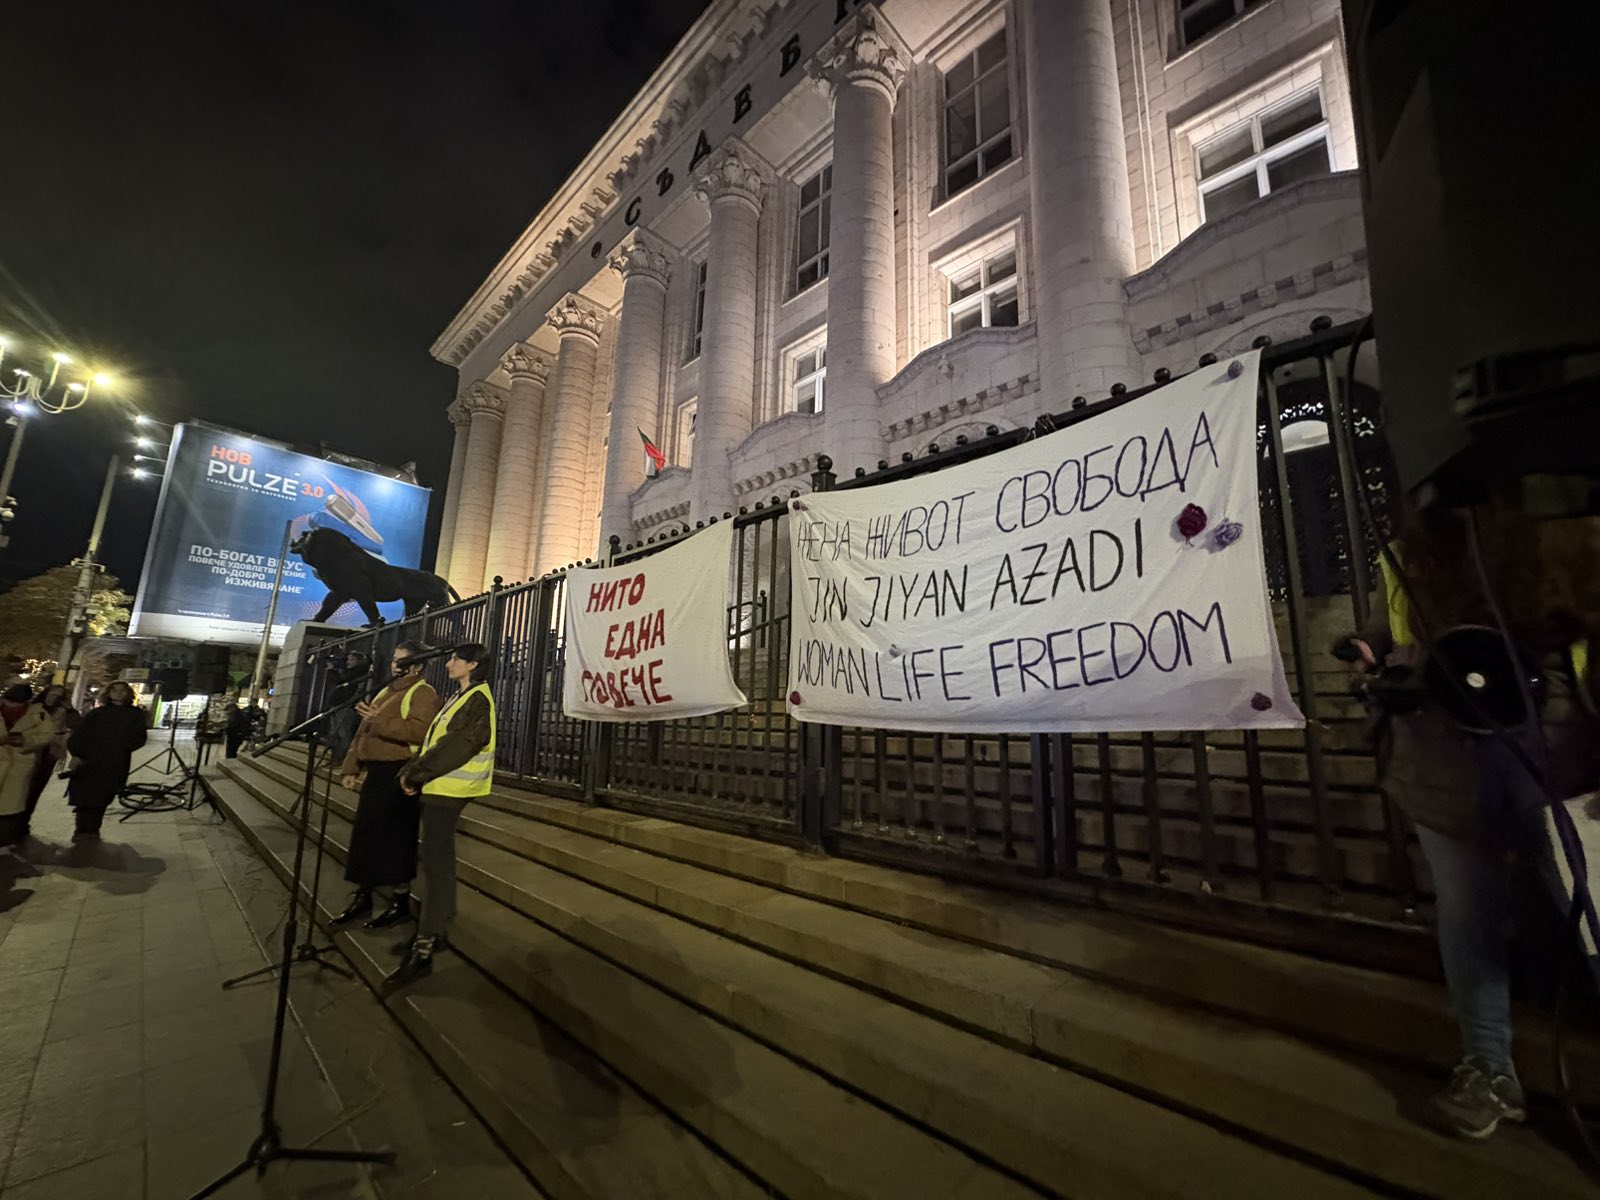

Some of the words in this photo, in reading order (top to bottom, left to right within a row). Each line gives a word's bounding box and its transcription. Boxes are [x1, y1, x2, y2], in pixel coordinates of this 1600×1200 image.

[210, 444, 254, 467] НОВ
[301, 482, 324, 498] 3.0
[864, 491, 975, 560] ЖИВОТ
[995, 411, 1219, 533] СВОБОДА
[188, 555, 226, 567] ПОВЕЧЕ
[190, 544, 265, 565] ПО-БОГАТ
[211, 566, 265, 581] ПО-ДОБРО
[808, 576, 848, 623] JIN
[859, 564, 967, 628] JIYAN
[990, 517, 1143, 611] AZADI
[585, 572, 645, 613] НИТО
[604, 608, 665, 661] ЕДНА
[798, 638, 870, 697] WOMAN
[875, 645, 971, 702] LIFE
[989, 601, 1232, 698] FREEDOM
[581, 659, 673, 708] ПОВЕЧЕ
